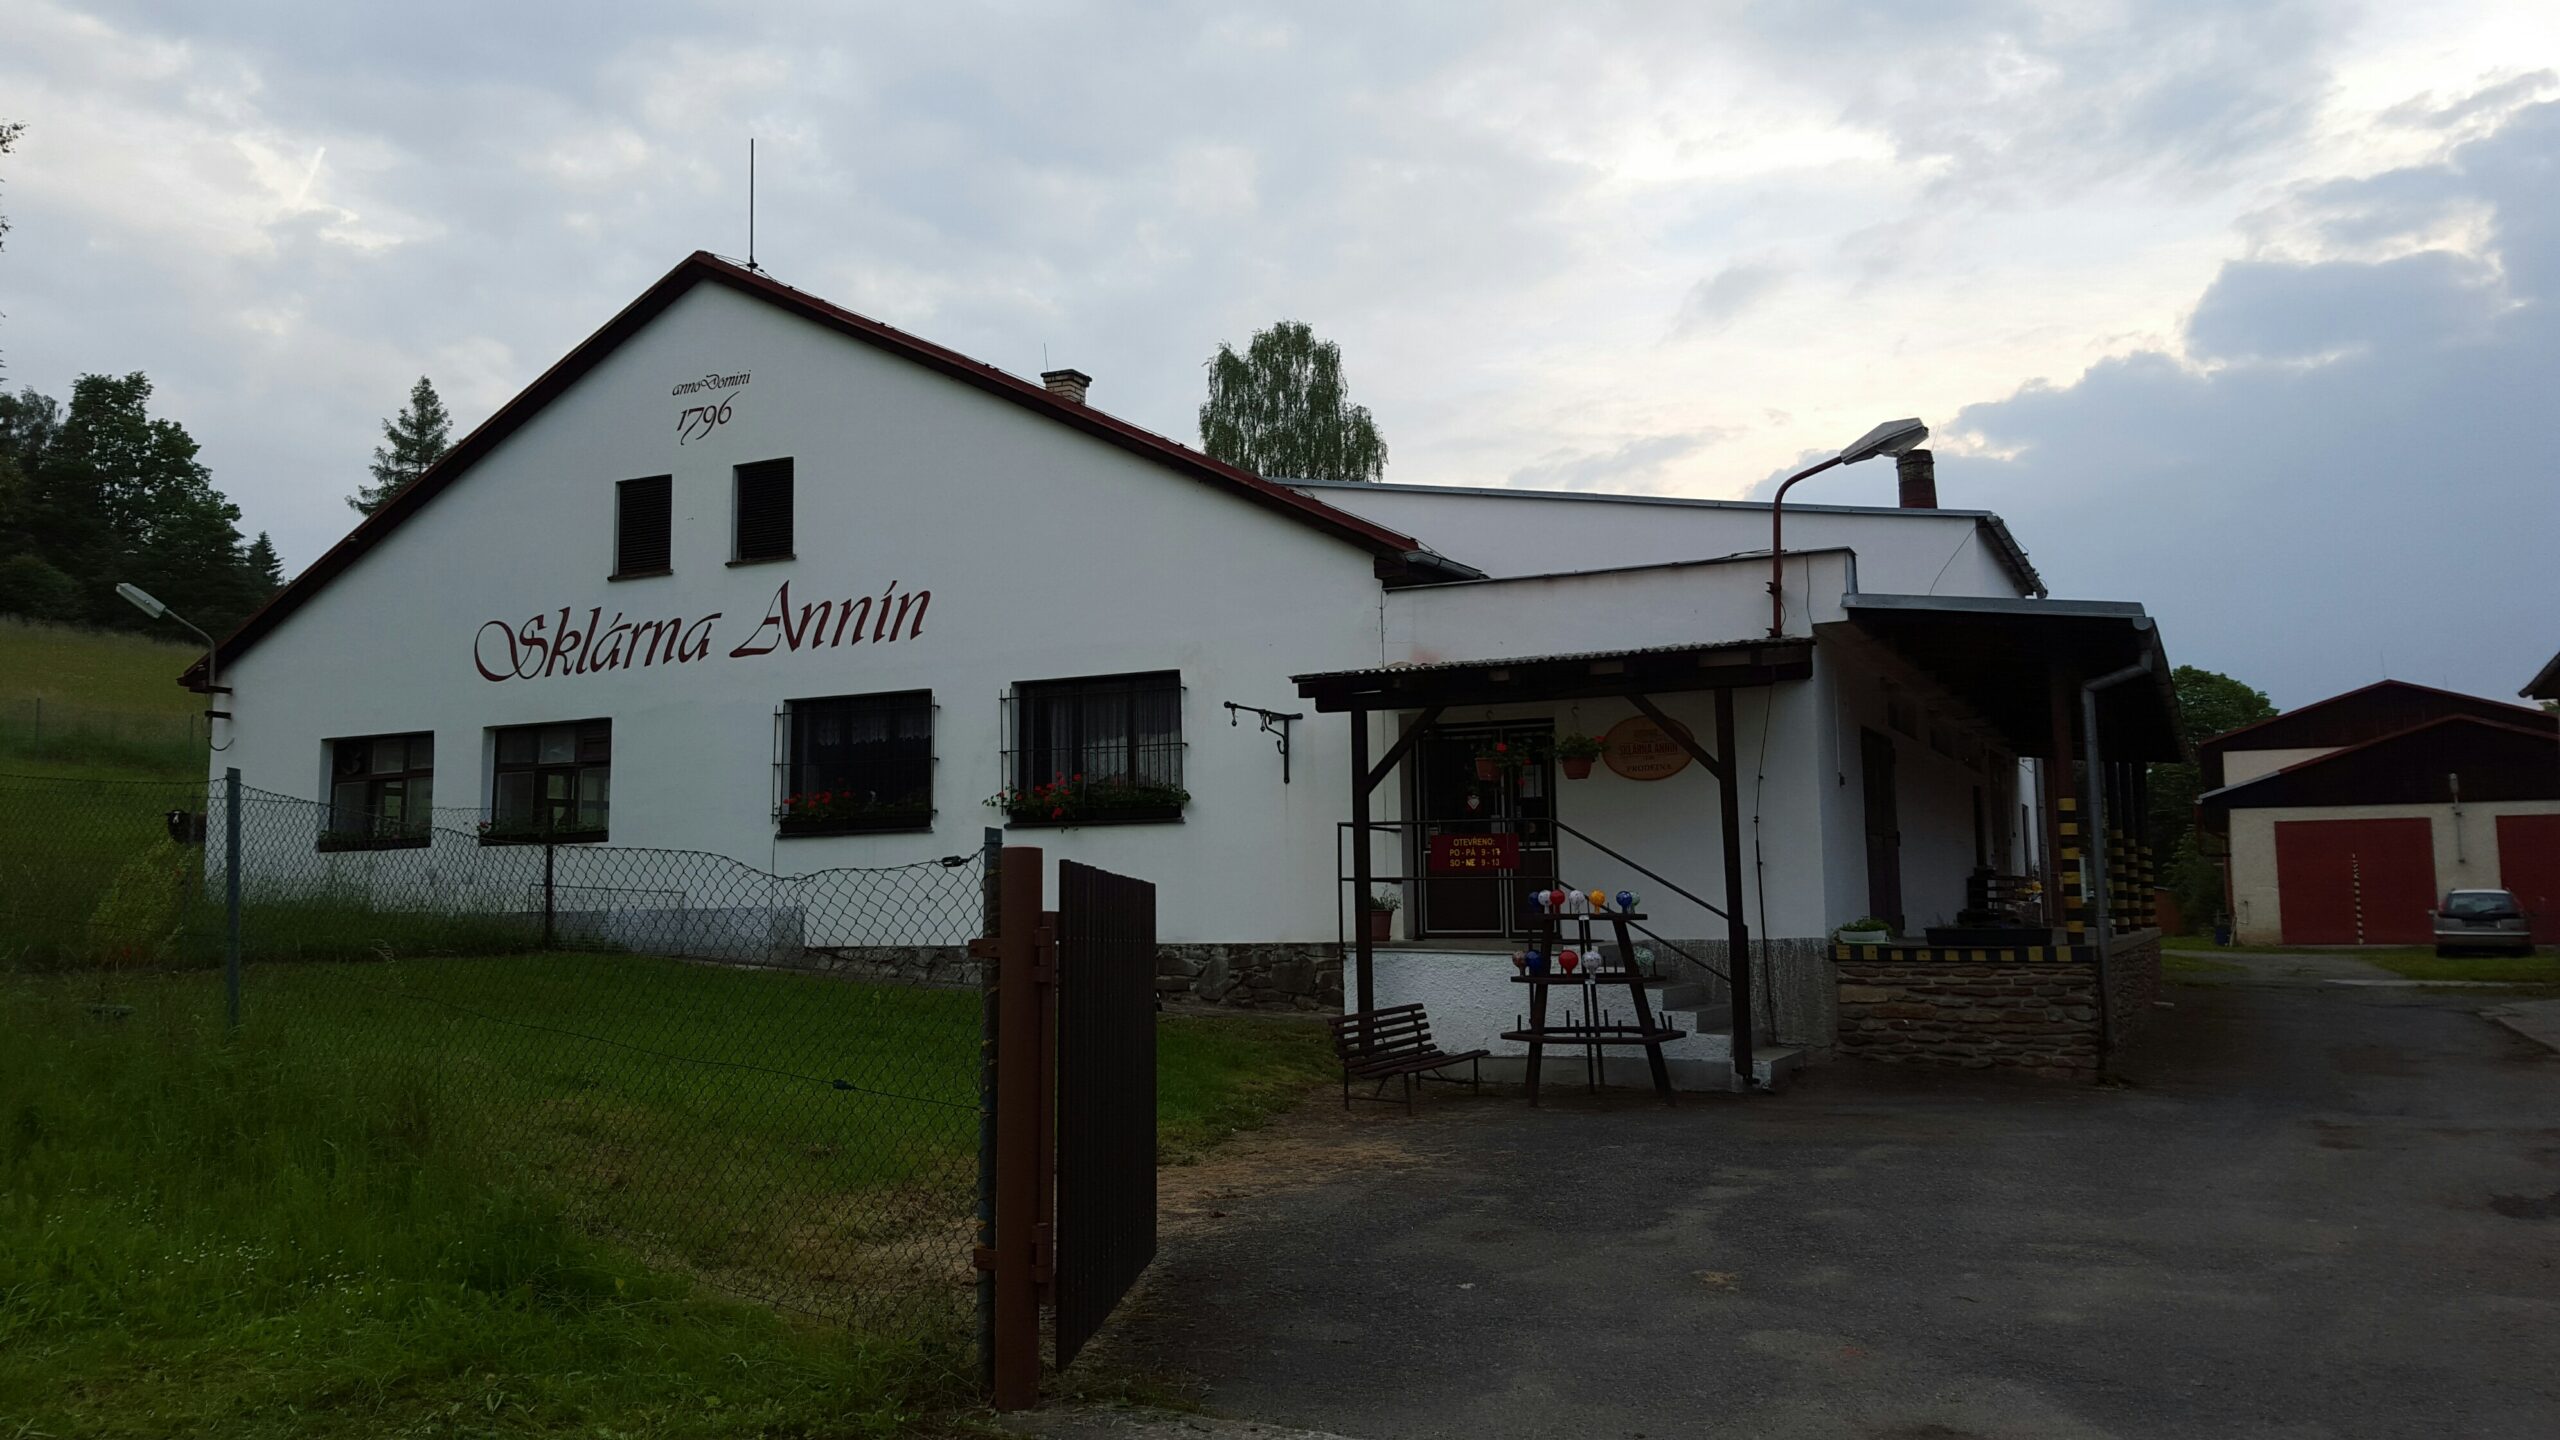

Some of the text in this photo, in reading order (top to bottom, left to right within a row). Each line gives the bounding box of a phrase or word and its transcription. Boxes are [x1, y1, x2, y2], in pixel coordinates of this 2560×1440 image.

[676, 391, 740, 446] 1796
[474, 579, 933, 683] Sklárna Annín
